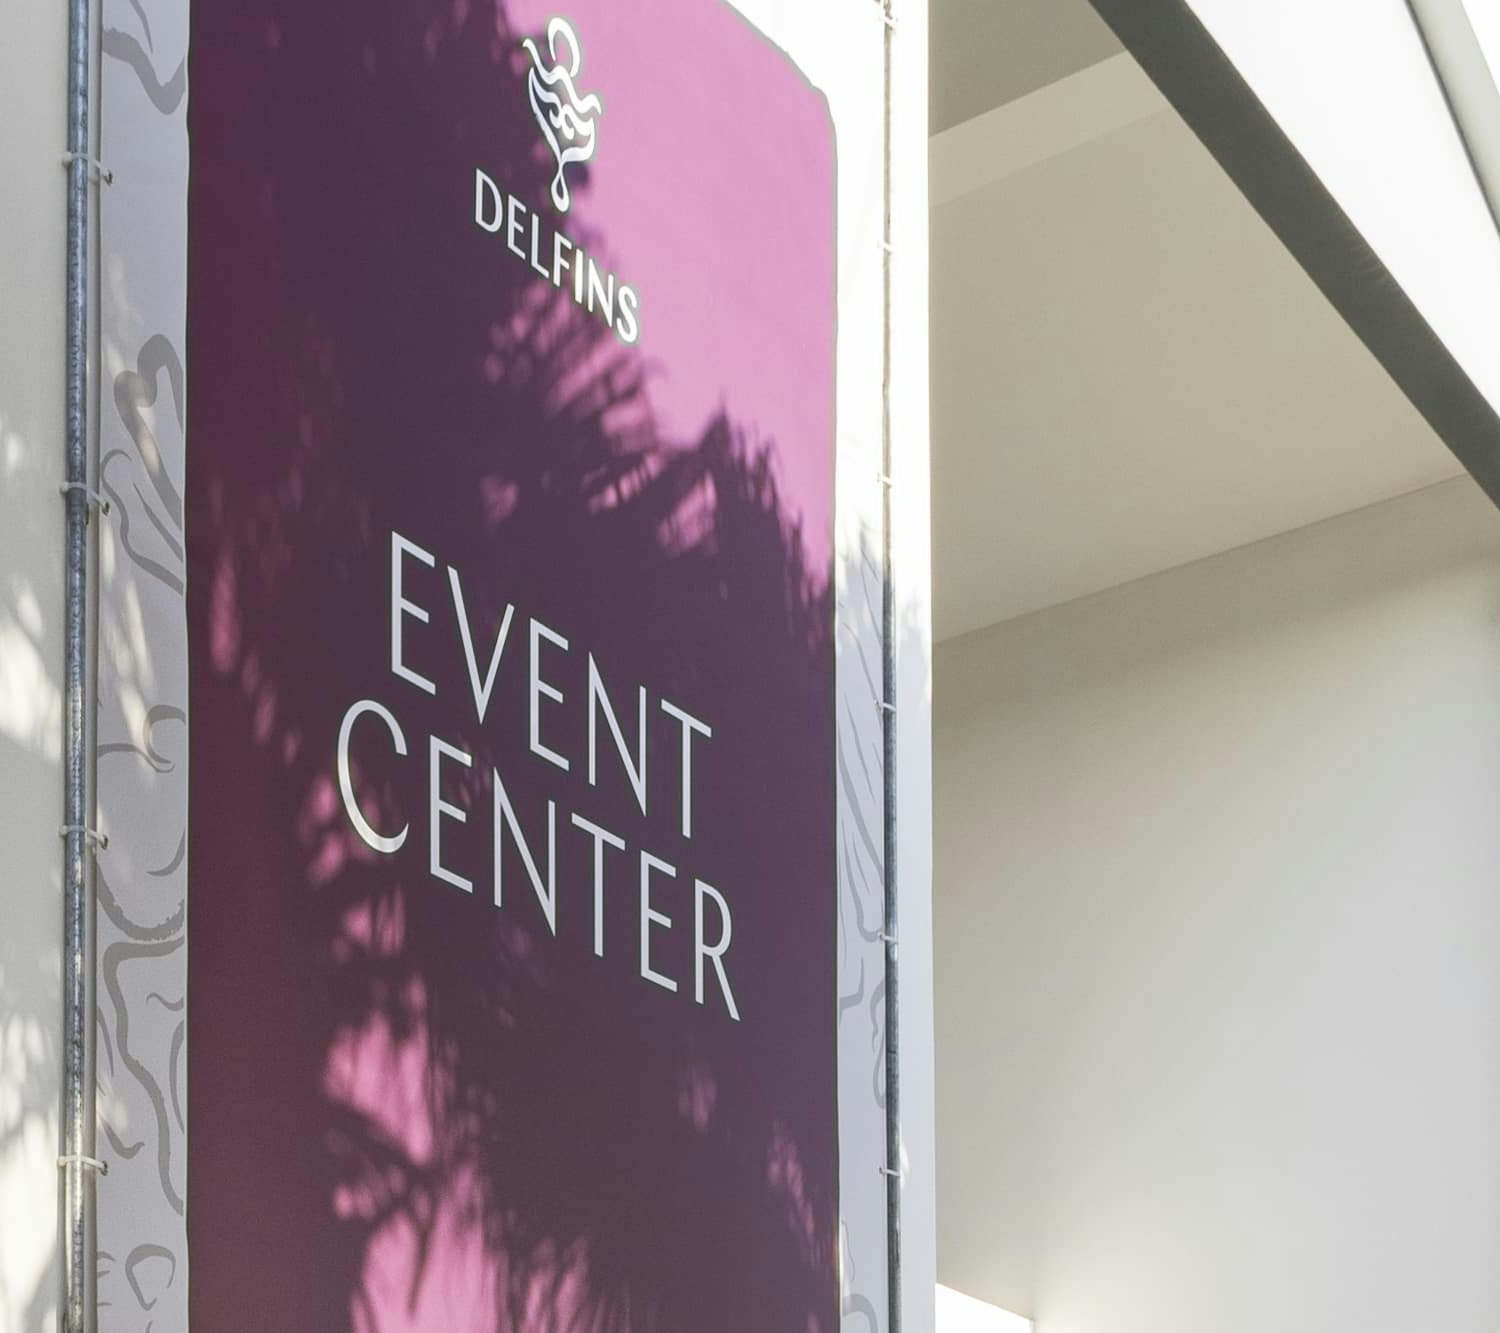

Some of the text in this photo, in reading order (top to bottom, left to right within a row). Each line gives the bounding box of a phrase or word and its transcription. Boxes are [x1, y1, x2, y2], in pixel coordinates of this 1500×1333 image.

[473, 168, 640, 344] DELFINS
[390, 530, 713, 839] EVENT
[336, 698, 741, 1022] CENTER
